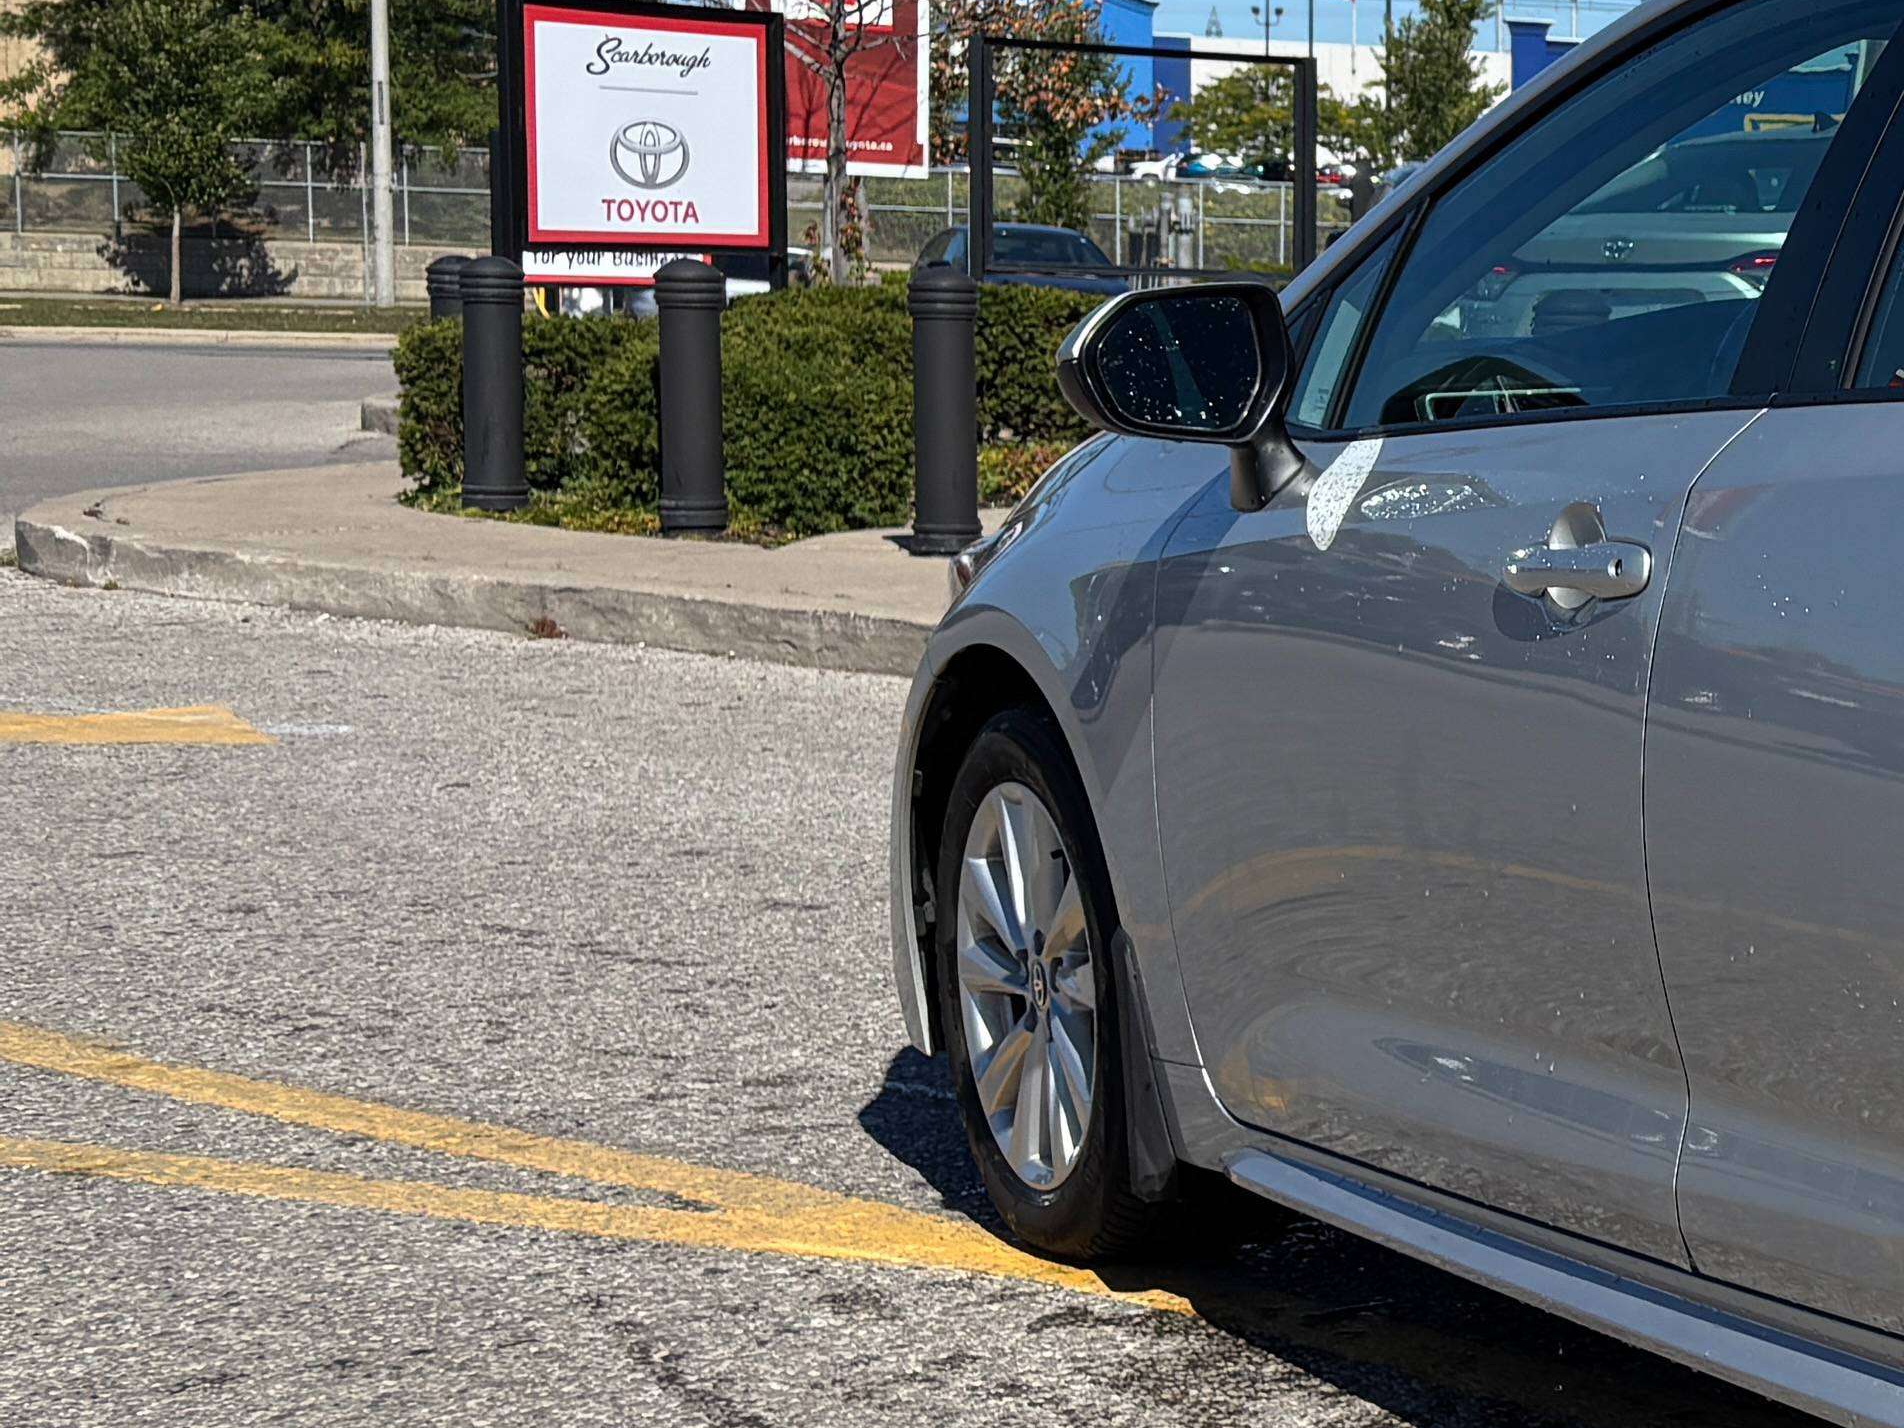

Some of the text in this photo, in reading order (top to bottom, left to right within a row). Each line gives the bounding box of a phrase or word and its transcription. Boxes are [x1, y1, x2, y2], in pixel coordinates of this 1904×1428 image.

[586, 34, 711, 78] Scarborough
[601, 198, 700, 224] TOYOTA
[567, 251, 605, 270] your
